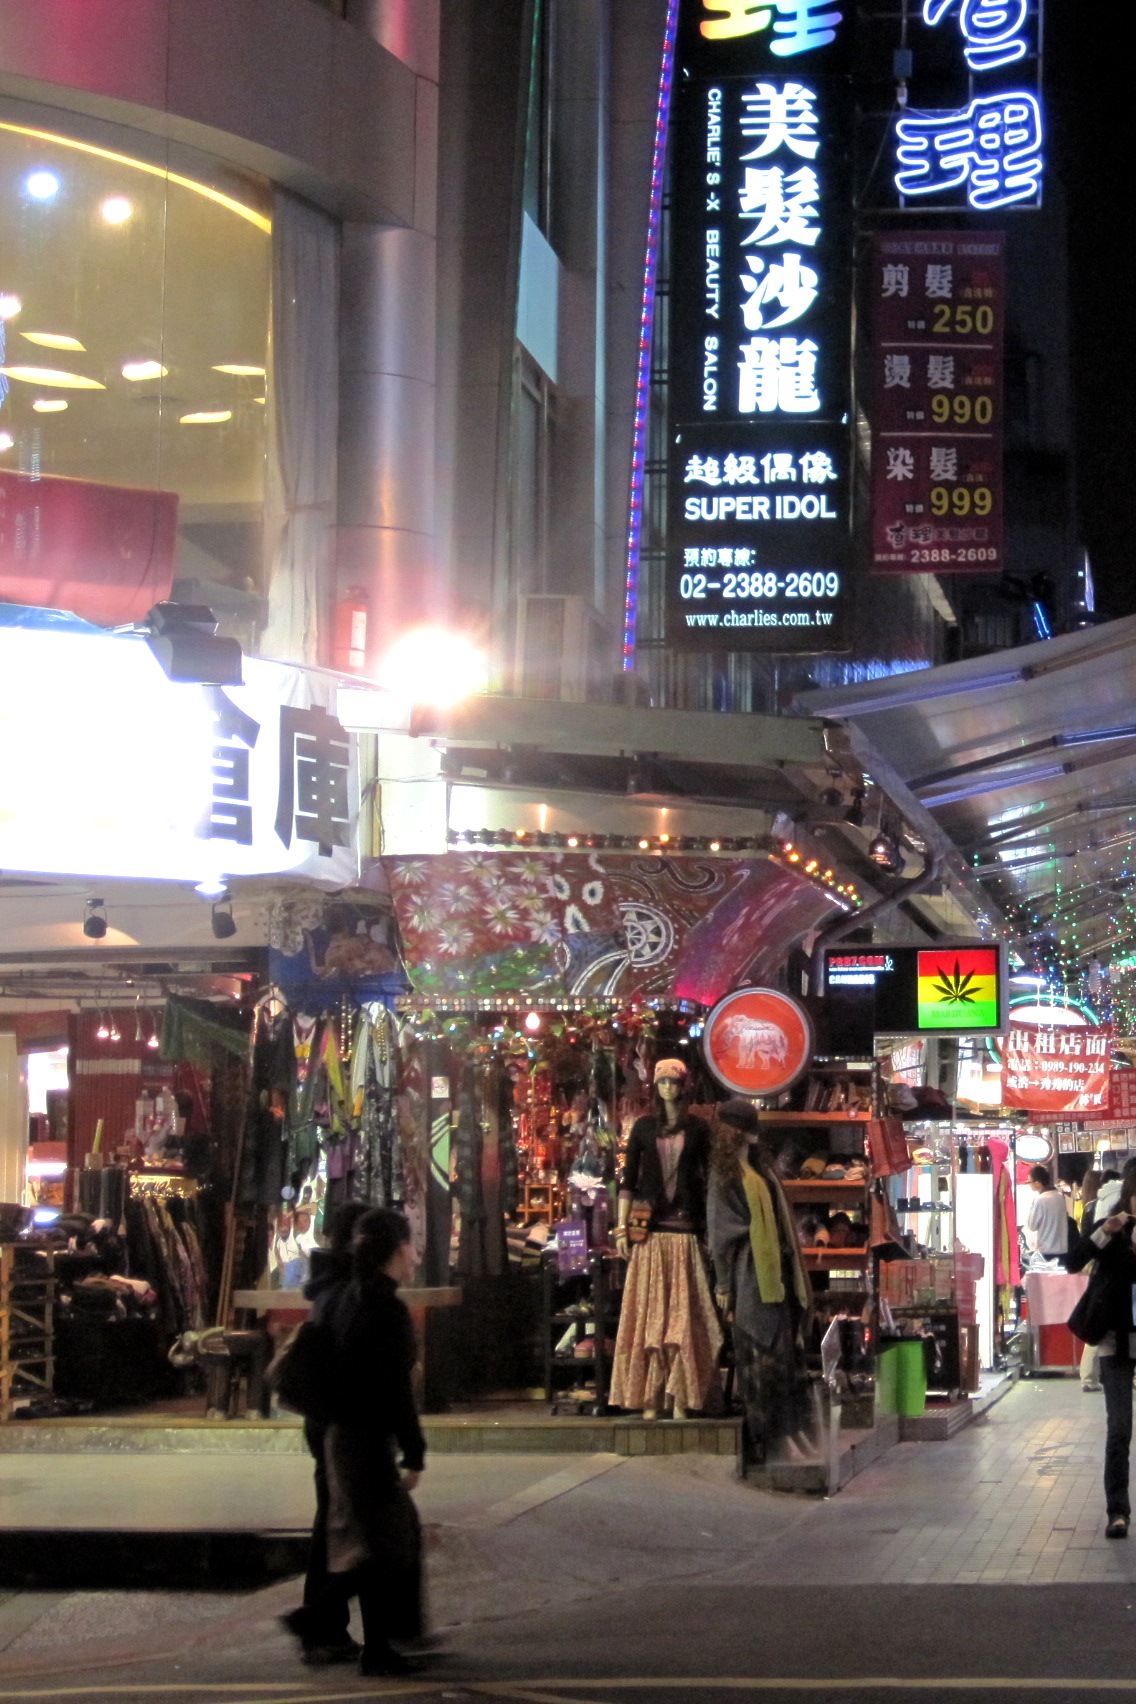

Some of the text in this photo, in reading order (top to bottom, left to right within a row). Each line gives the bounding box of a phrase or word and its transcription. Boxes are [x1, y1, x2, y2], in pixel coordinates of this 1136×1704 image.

[738, 81, 822, 414] 美髮沙龍
[704, 229, 720, 320] BEAUTY
[932, 303, 994, 335] 250
[702, 336, 720, 412] SALON
[931, 393, 993, 425] 990
[684, 450, 839, 487] 超級偶像
[684, 494, 838, 521] SUPER IDOL
[930, 486, 993, 517] 999
[910, 547, 998, 563] 2388-2609
[679, 571, 840, 600] 02-2388-2609
[685, 608, 834, 628] www.charlies.com.tw
[1007, 1029, 1108, 1057] 出租店面
